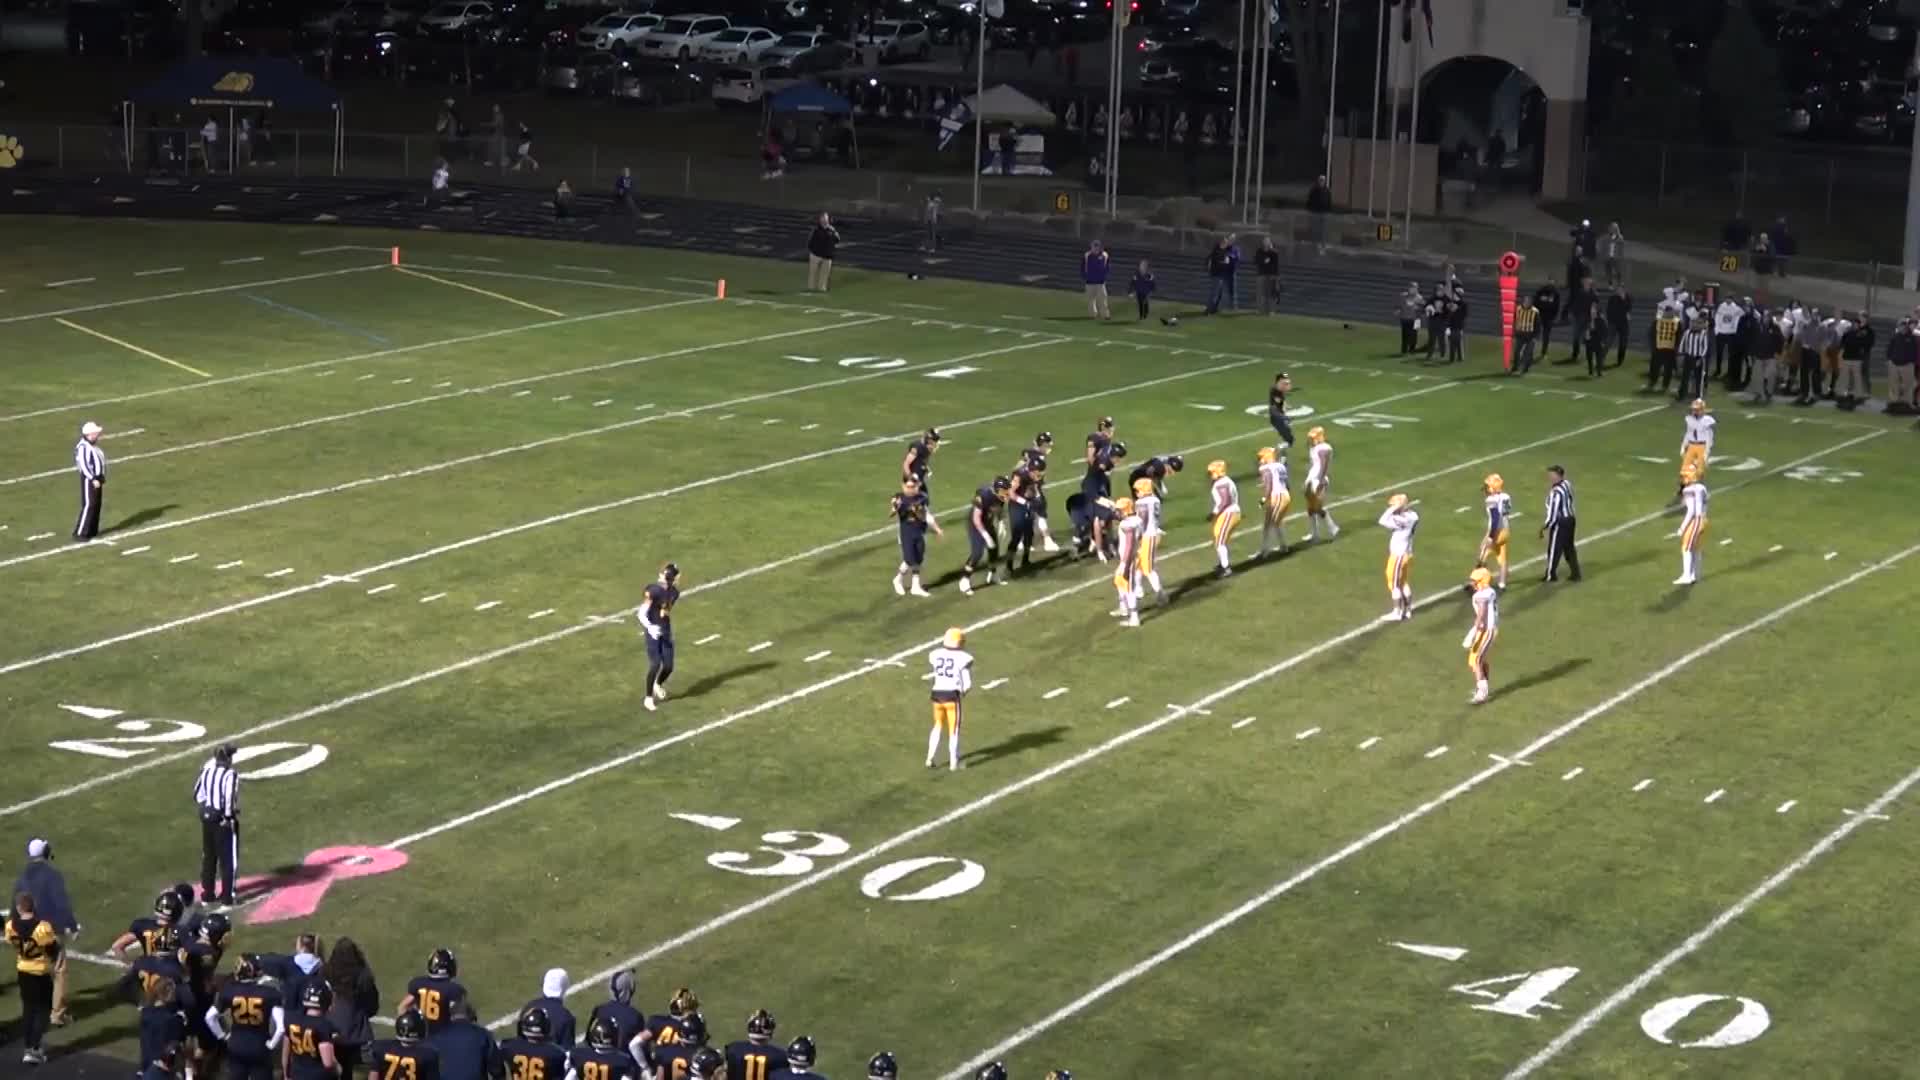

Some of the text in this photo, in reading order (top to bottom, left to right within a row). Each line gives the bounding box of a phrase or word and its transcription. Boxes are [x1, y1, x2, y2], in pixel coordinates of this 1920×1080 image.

[1721, 256, 1737, 271] 20
[935, 656, 955, 678] 22
[231, 996, 264, 1026] 25
[417, 988, 441, 1021] 16
[288, 1023, 317, 1056] 54
[384, 1053, 417, 1080] 73
[513, 1054, 545, 1080] 36
[744, 1053, 767, 1080] 11
